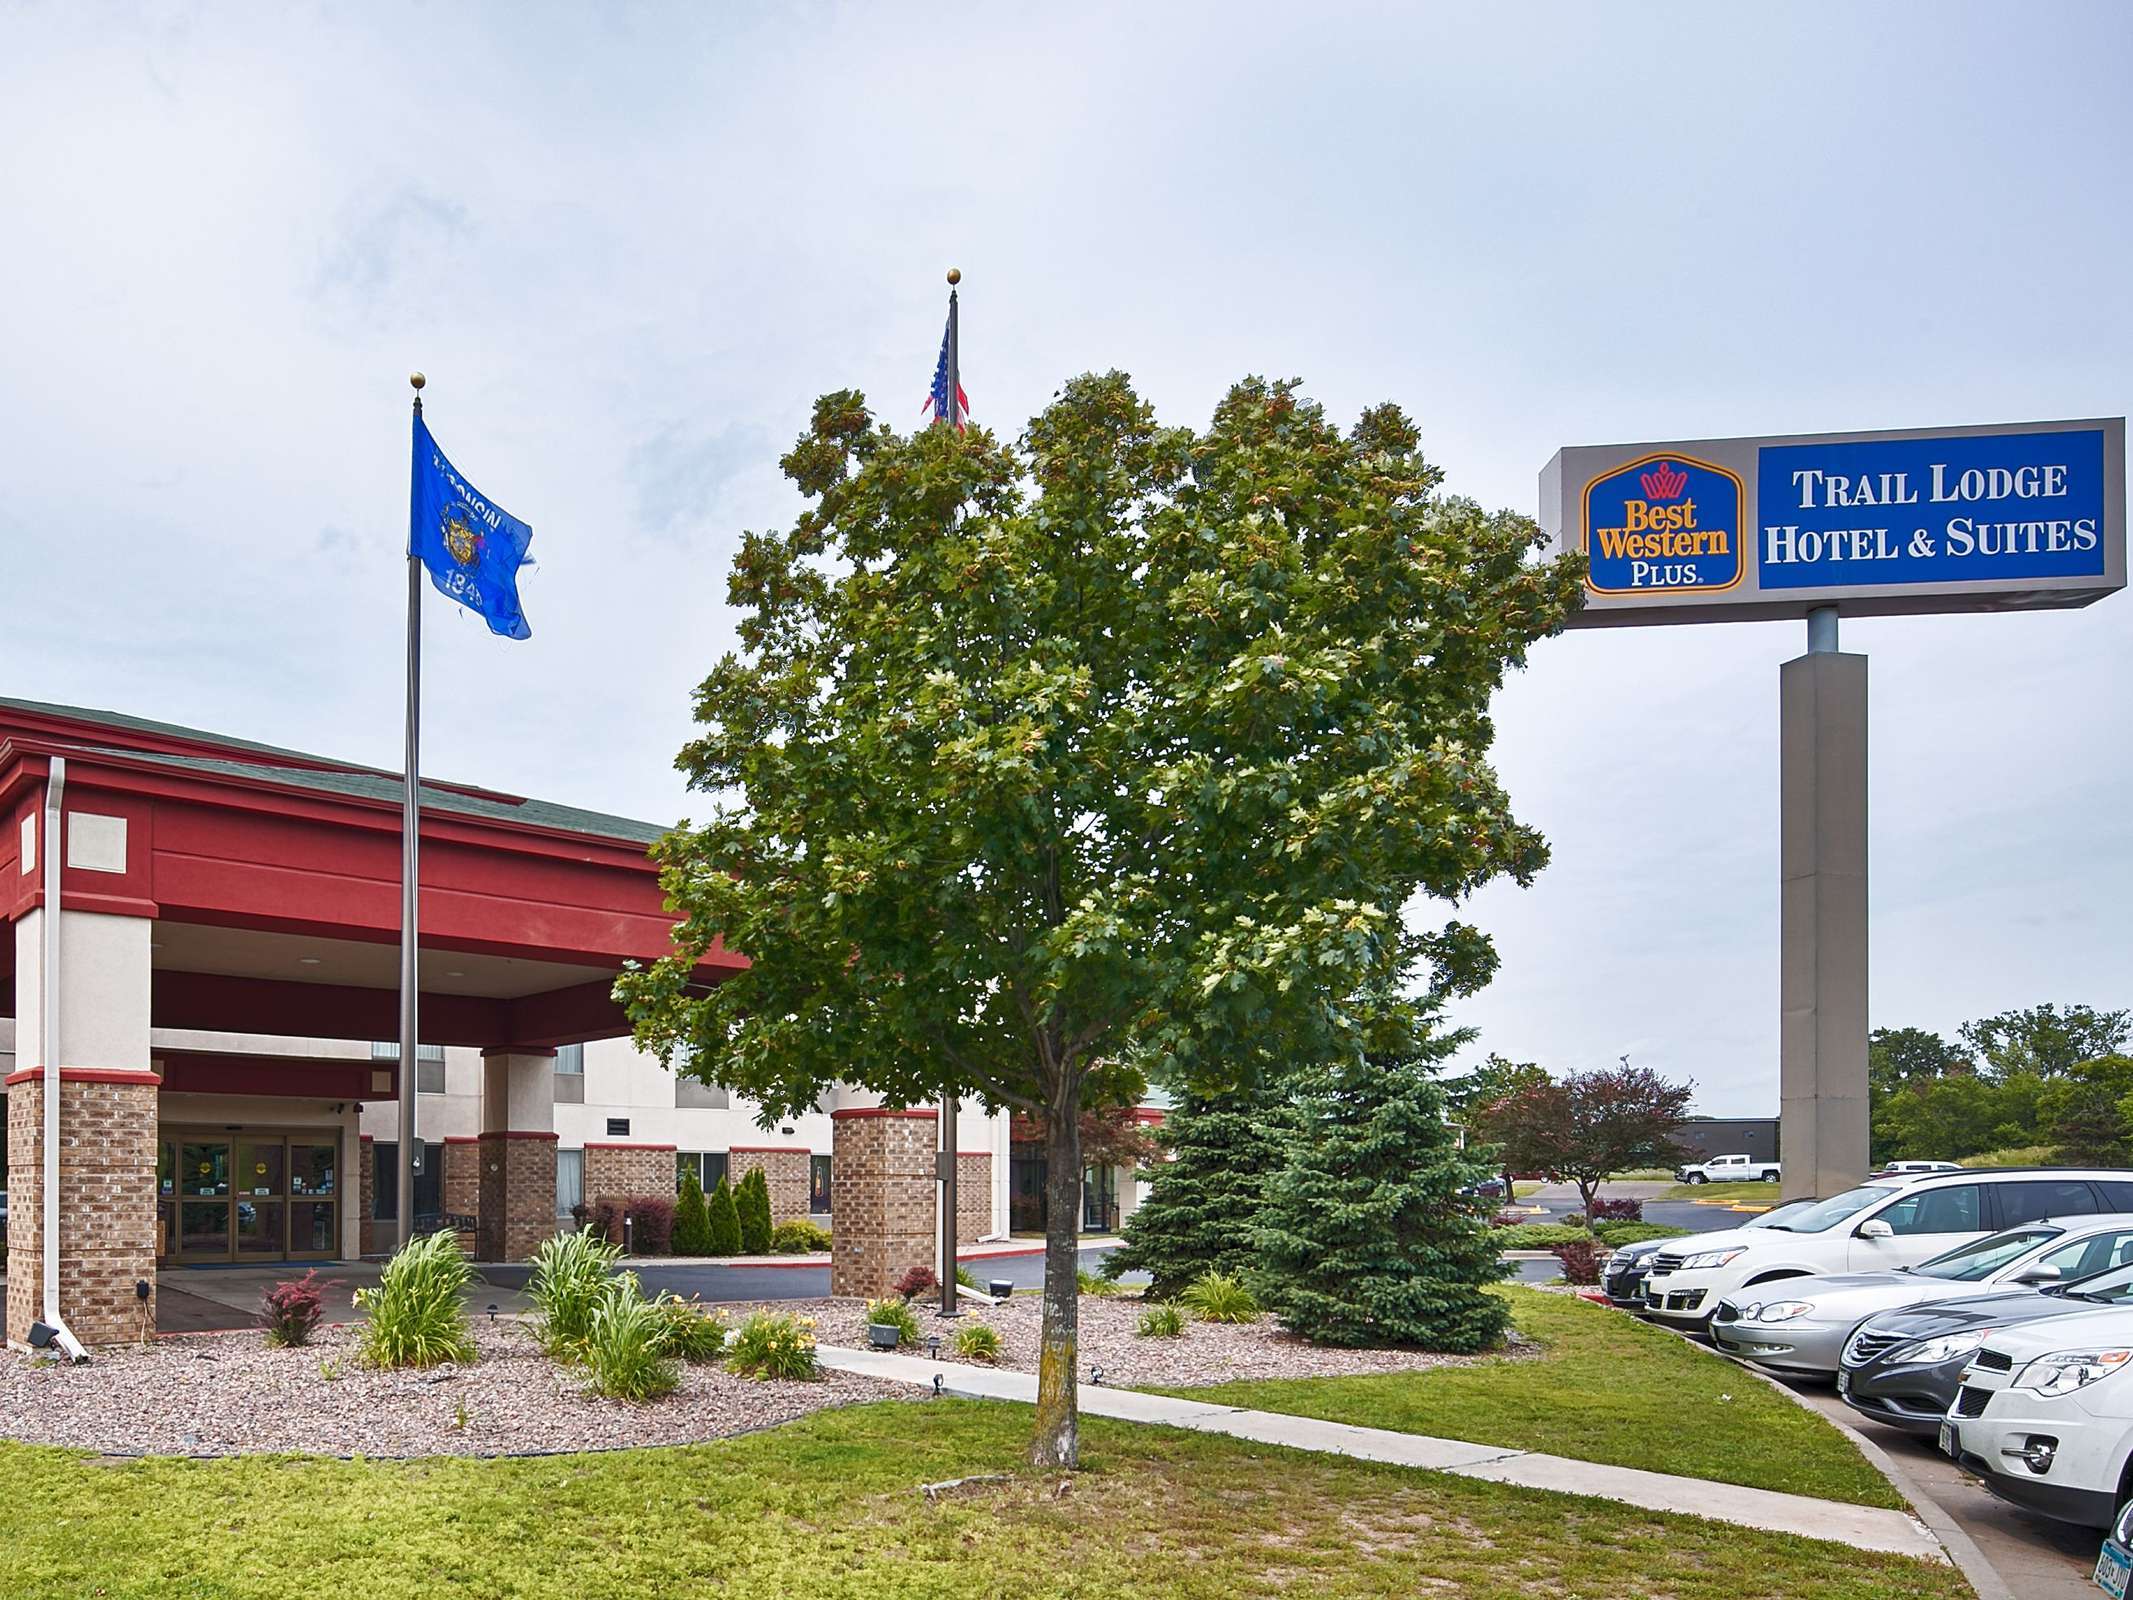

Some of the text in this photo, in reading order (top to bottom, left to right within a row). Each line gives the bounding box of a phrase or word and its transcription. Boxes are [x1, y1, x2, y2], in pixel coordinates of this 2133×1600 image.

[1792, 464, 2068, 508] TRAIL LODGE
[1624, 498, 1697, 532] Best
[1597, 527, 1730, 559] Western
[1764, 518, 2098, 564] HOTEL & SUITES
